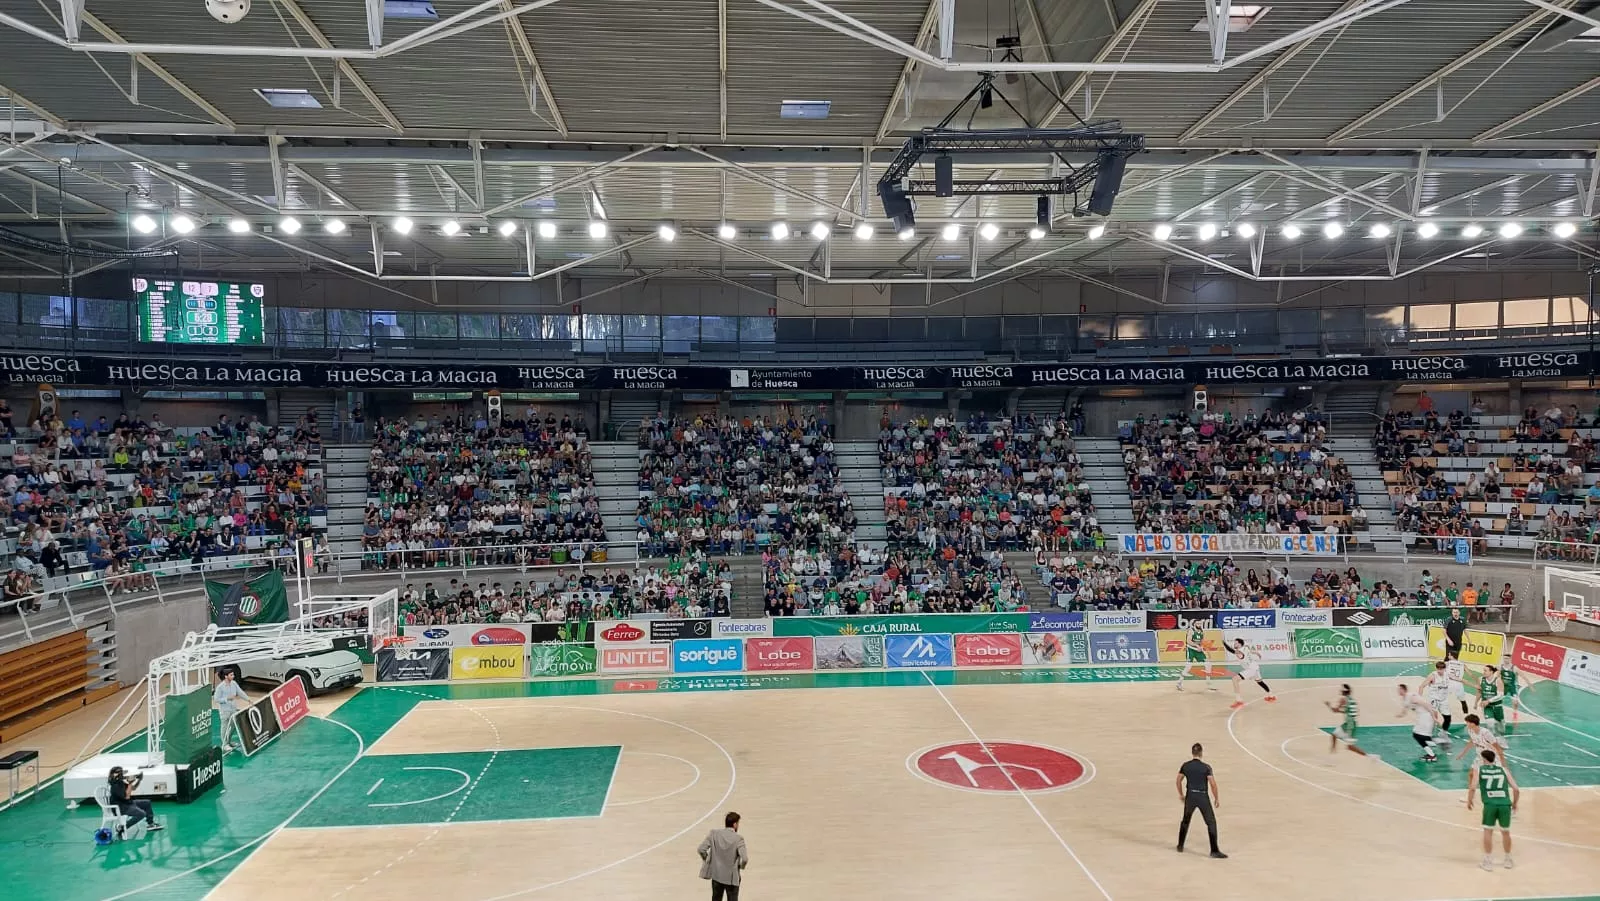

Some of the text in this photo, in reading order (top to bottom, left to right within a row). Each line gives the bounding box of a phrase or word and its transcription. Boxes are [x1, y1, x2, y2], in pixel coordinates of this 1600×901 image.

[751, 370, 812, 380] Ayuntamiento
[752, 380, 798, 388] de Huesca
[1124, 534, 1336, 552] NACHO BIOTA LEYENDA OSCENSE
[1223, 615, 1271, 626] SERFEY
[607, 630, 640, 638] Ferrer
[863, 624, 922, 633] CAJA RURAL
[608, 650, 664, 664] UNITIC
[759, 650, 800, 660] Lobe
[966, 646, 1010, 656] Lobe
[1096, 648, 1150, 660] GASBY
[461, 656, 515, 670] embou
[1522, 652, 1554, 667] Lobe
[280, 695, 301, 716] Lobe
[192, 709, 212, 724] Lobe
[193, 760, 220, 790] Huesca
[1481, 775, 1504, 788] 77
